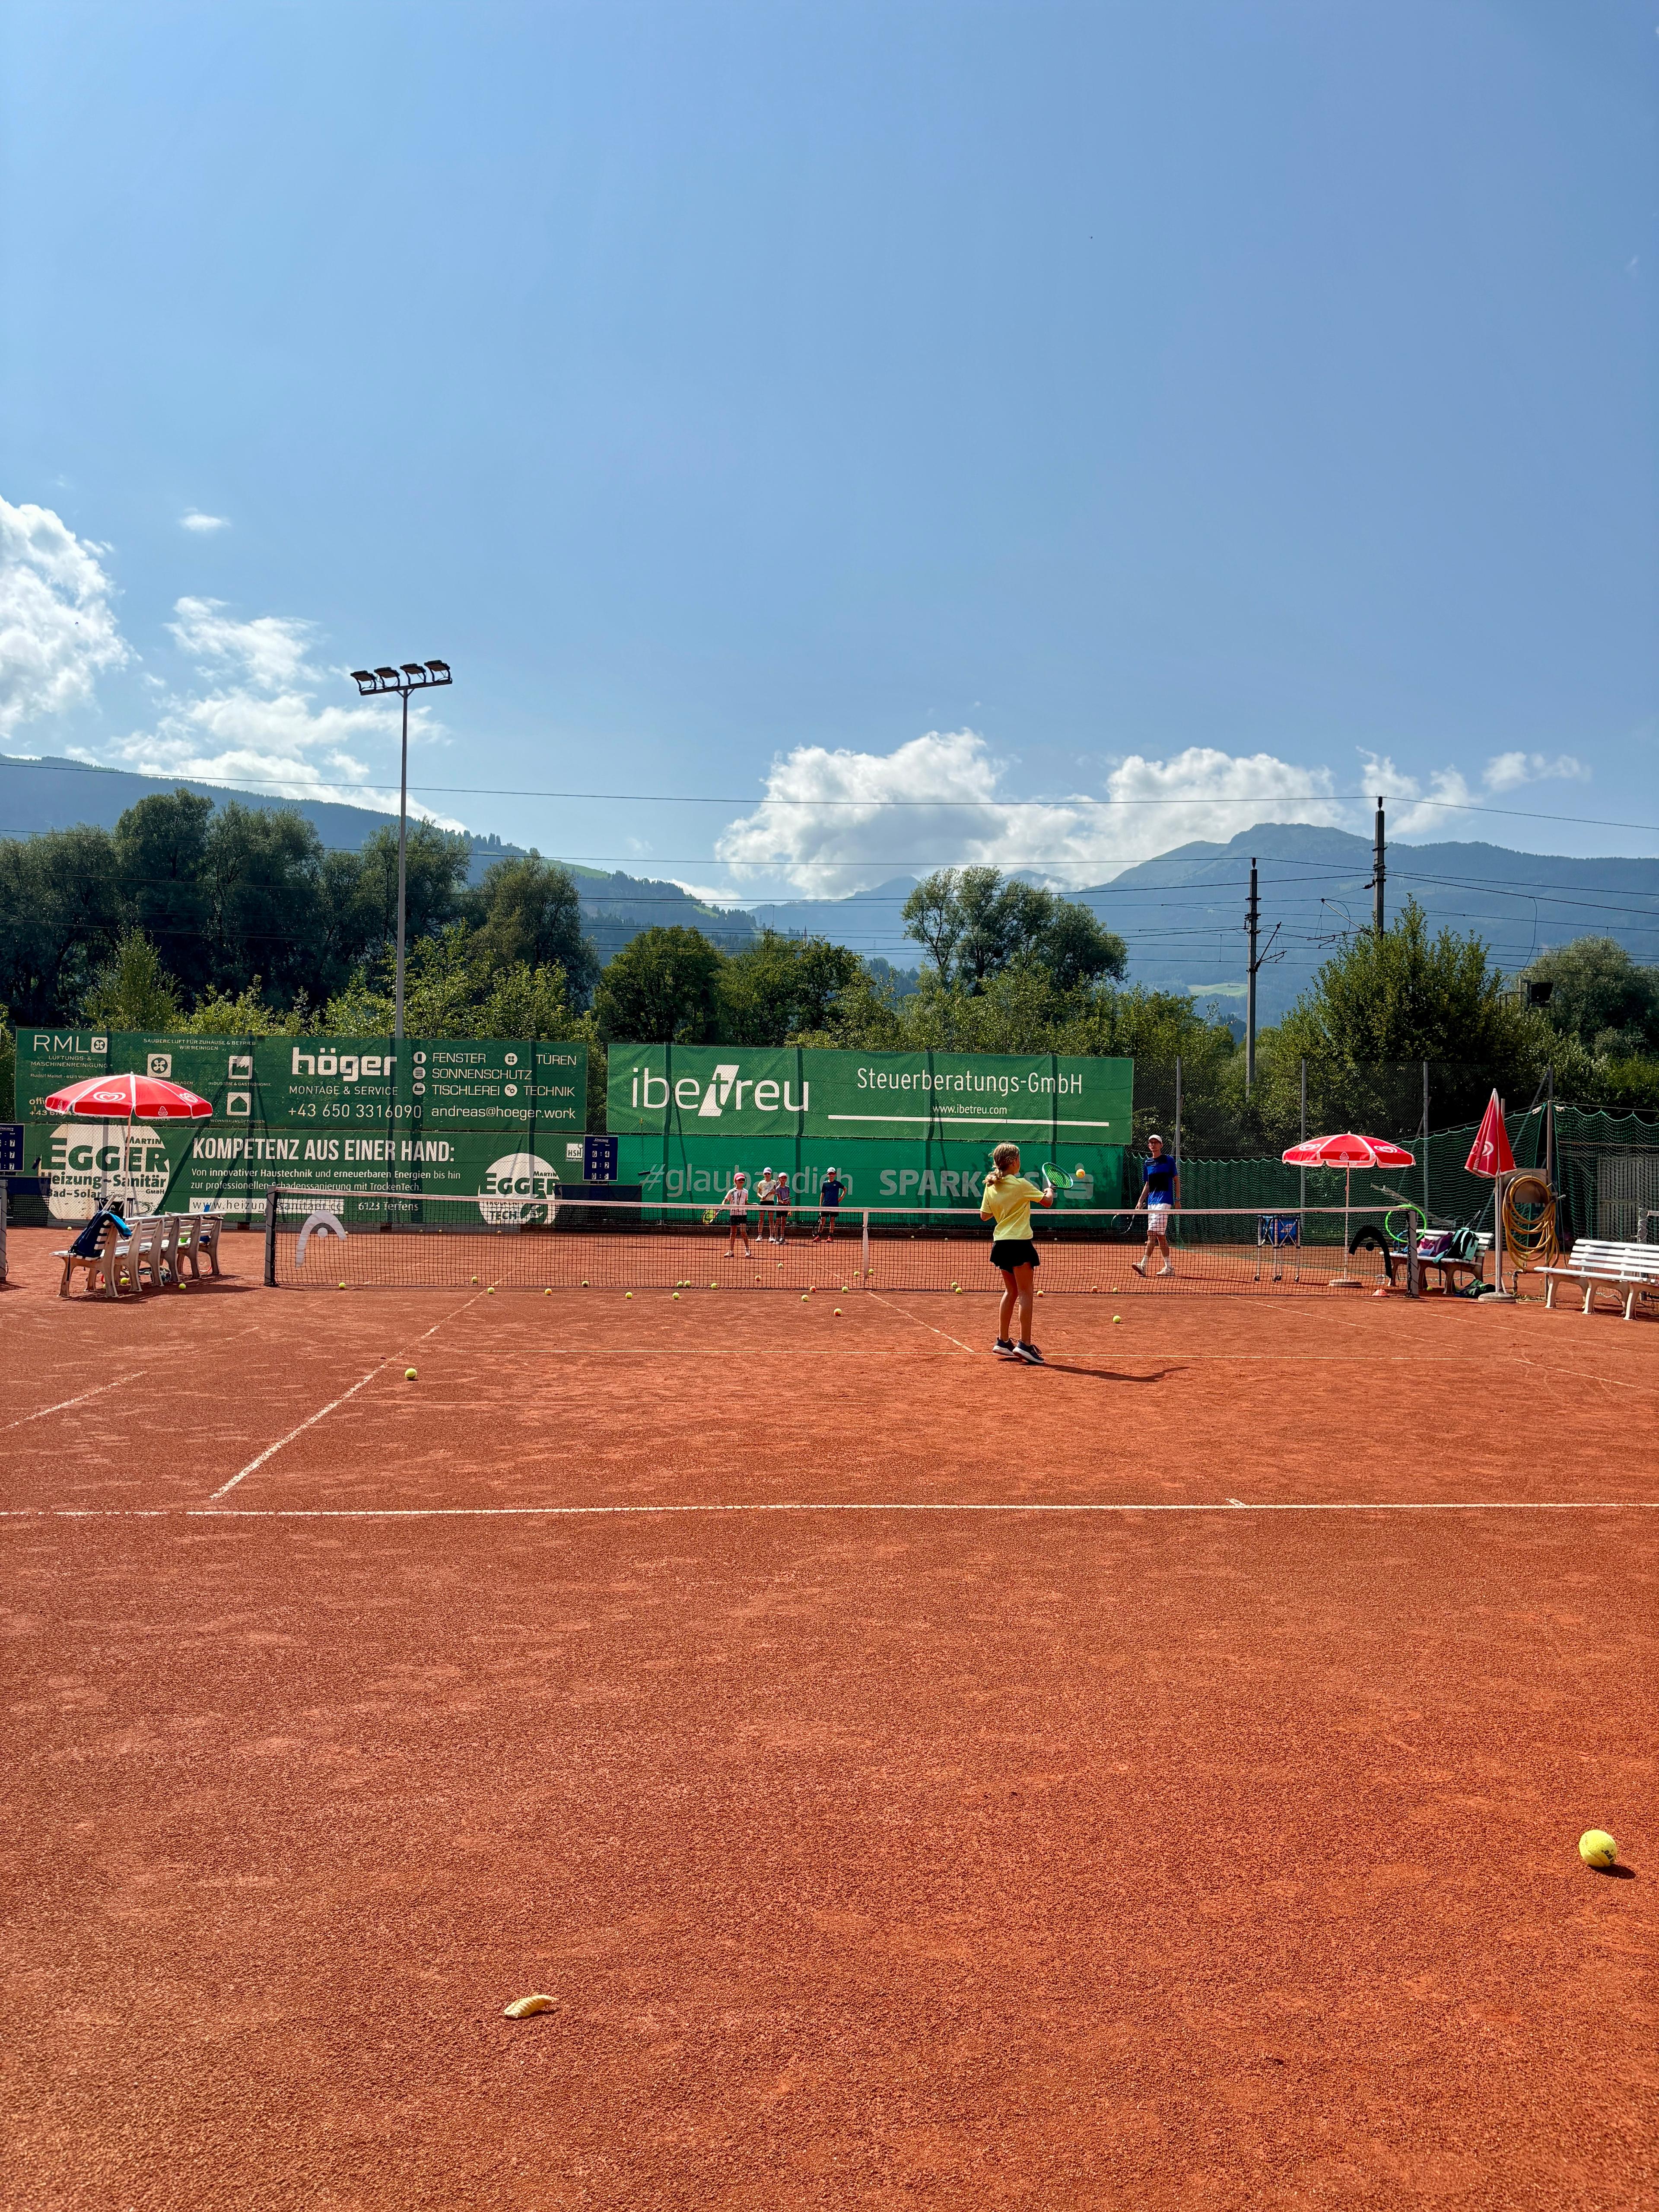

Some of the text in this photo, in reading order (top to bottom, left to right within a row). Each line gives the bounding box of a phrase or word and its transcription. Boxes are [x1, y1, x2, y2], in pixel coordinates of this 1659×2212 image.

[33, 1035, 89, 1053] RML
[433, 1053, 486, 1063] FENSTER
[536, 1053, 576, 1065] TÜREN
[292, 1047, 397, 1082] höger
[432, 1068, 532, 1080] SONNENSCHUTZ
[857, 1068, 1082, 1096] Steuerberatungs-GmbH
[289, 1086, 398, 1095] MONTAGE & SERVICE
[432, 1085, 500, 1096] TISCHLEREI
[523, 1086, 575, 1096] TECHNIK
[632, 1068, 809, 1112] ibetreu
[288, 1104, 422, 1118] +43 650 3316090
[432, 1106, 576, 1121] andreas@hoeger.work
[933, 1104, 1007, 1115] www.ibetreu.com
[41, 1137, 169, 1173] EGGER
[193, 1138, 455, 1162] KOMPETENZ AUS EINER HAND:
[210, 1168, 258, 1176] innovativer
[261, 1169, 312, 1177] Haustechnik
[315, 1170, 331, 1178] und
[334, 1170, 391, 1178] erneuerbaren
[394, 1170, 431, 1180] Energien
[434, 1171, 445, 1179] bis
[448, 1171, 461, 1179] hin
[206, 1181, 269, 1191] professionellen
[370, 1182, 422, 1191] TrockenTech.
